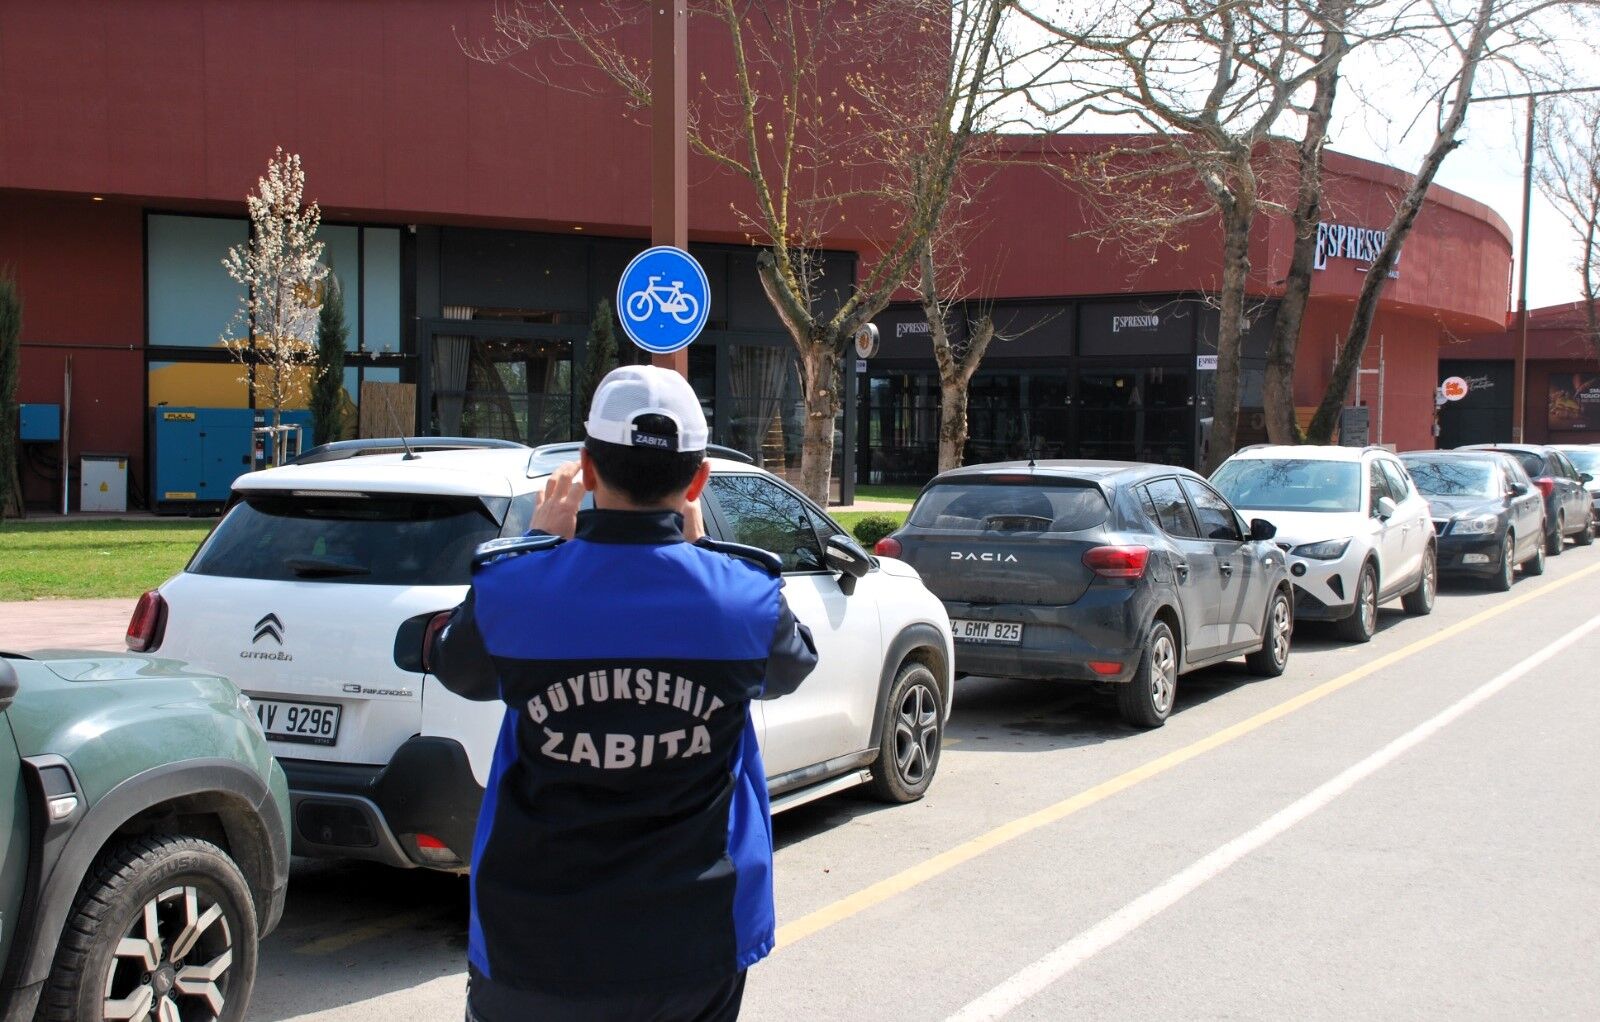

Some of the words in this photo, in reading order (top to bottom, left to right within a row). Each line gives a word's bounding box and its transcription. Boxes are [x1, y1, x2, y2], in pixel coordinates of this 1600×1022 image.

[1313, 222, 1402, 271] ESPRESSI
[896, 322, 930, 338] ESPRESSI
[1112, 316, 1159, 332] ESPRESSIVO
[635, 435, 668, 447] ZABITA
[950, 551, 1018, 563] DACIA
[949, 621, 959, 636] 4
[965, 622, 990, 637] GMM
[994, 624, 1019, 639] 825
[239, 650, 293, 662] CITROËN
[286, 706, 334, 735] 9296
[540, 724, 712, 770] ZABITA
